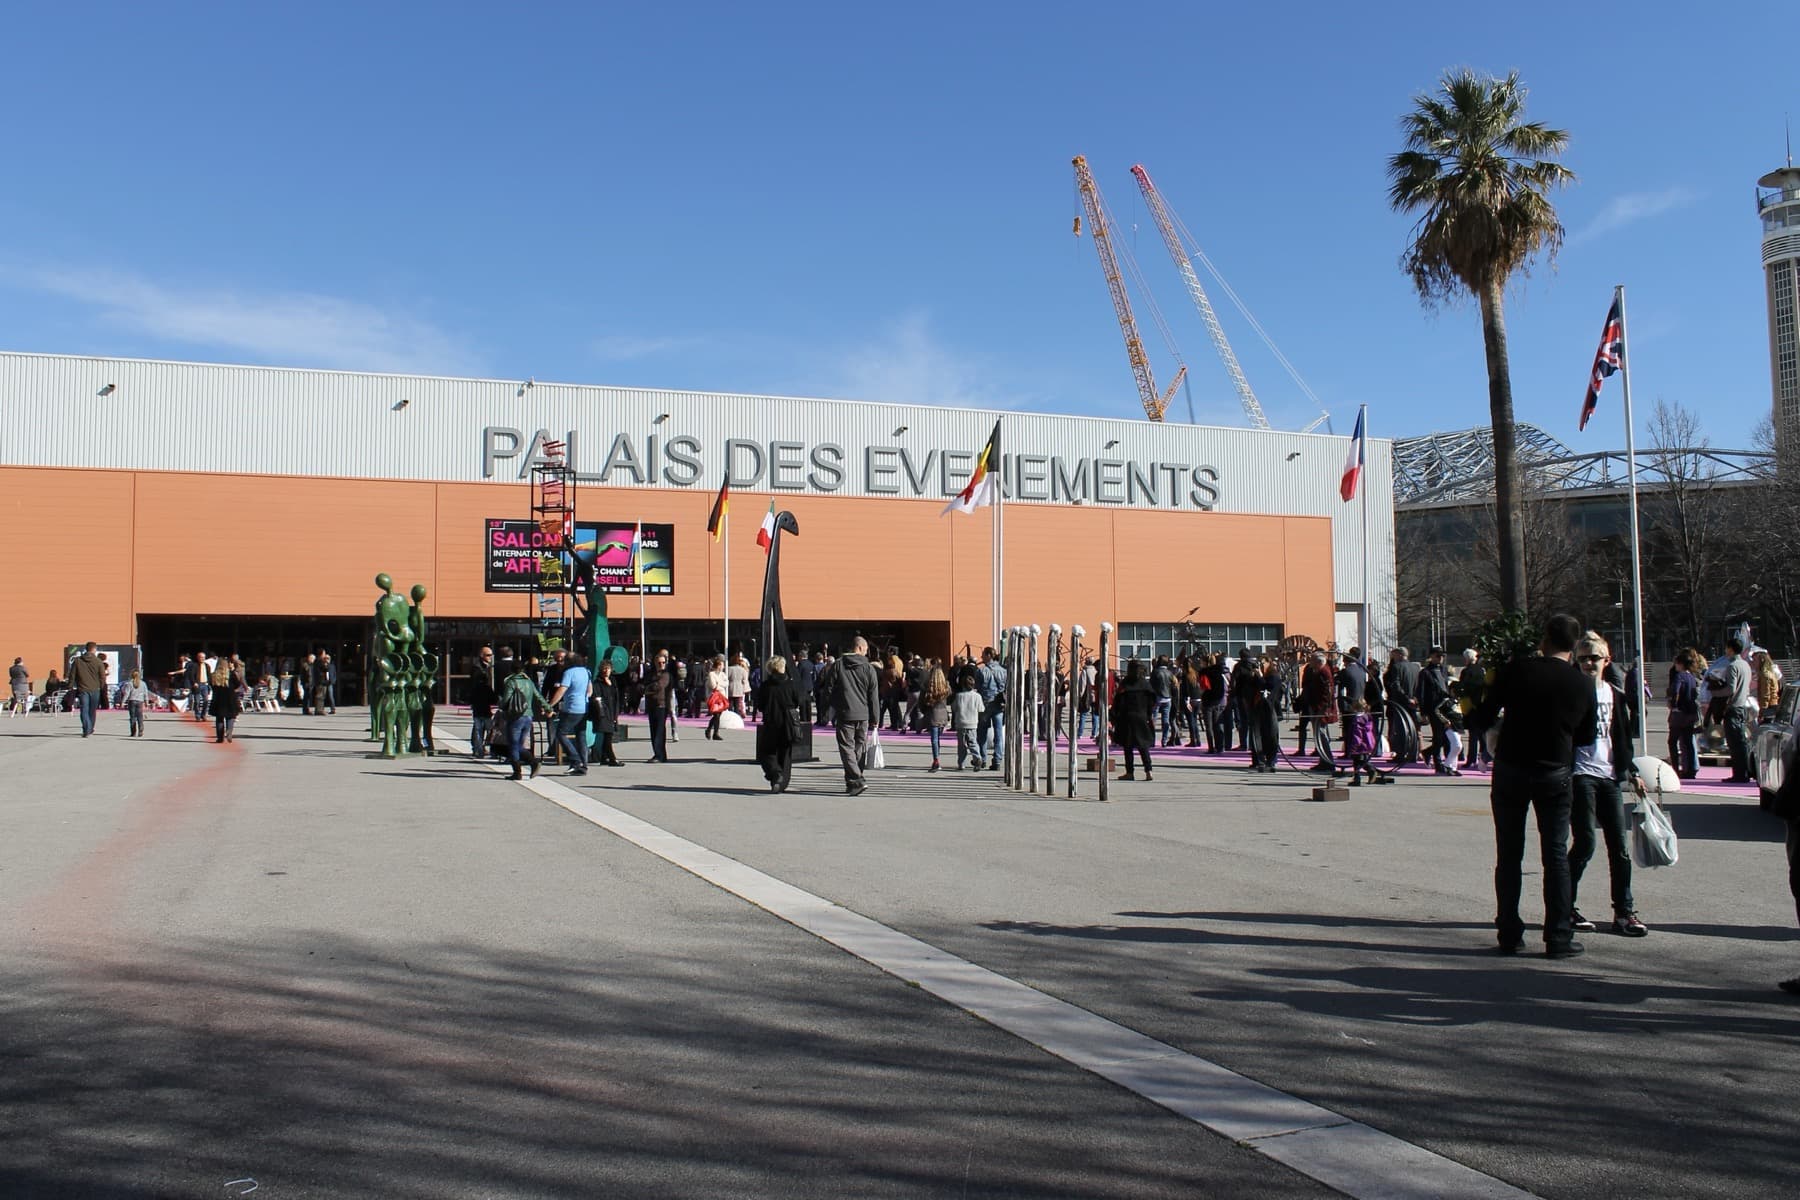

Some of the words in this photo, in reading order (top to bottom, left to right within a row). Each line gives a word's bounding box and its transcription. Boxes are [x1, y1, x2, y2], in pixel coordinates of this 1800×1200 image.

[483, 426, 704, 486] PALAIS
[726, 438, 846, 491] DES
[493, 531, 559, 548] SALON
[641, 540, 659, 548] ARS
[493, 549, 555, 558] INTERNATOAL
[597, 576, 634, 585] SEILLE
